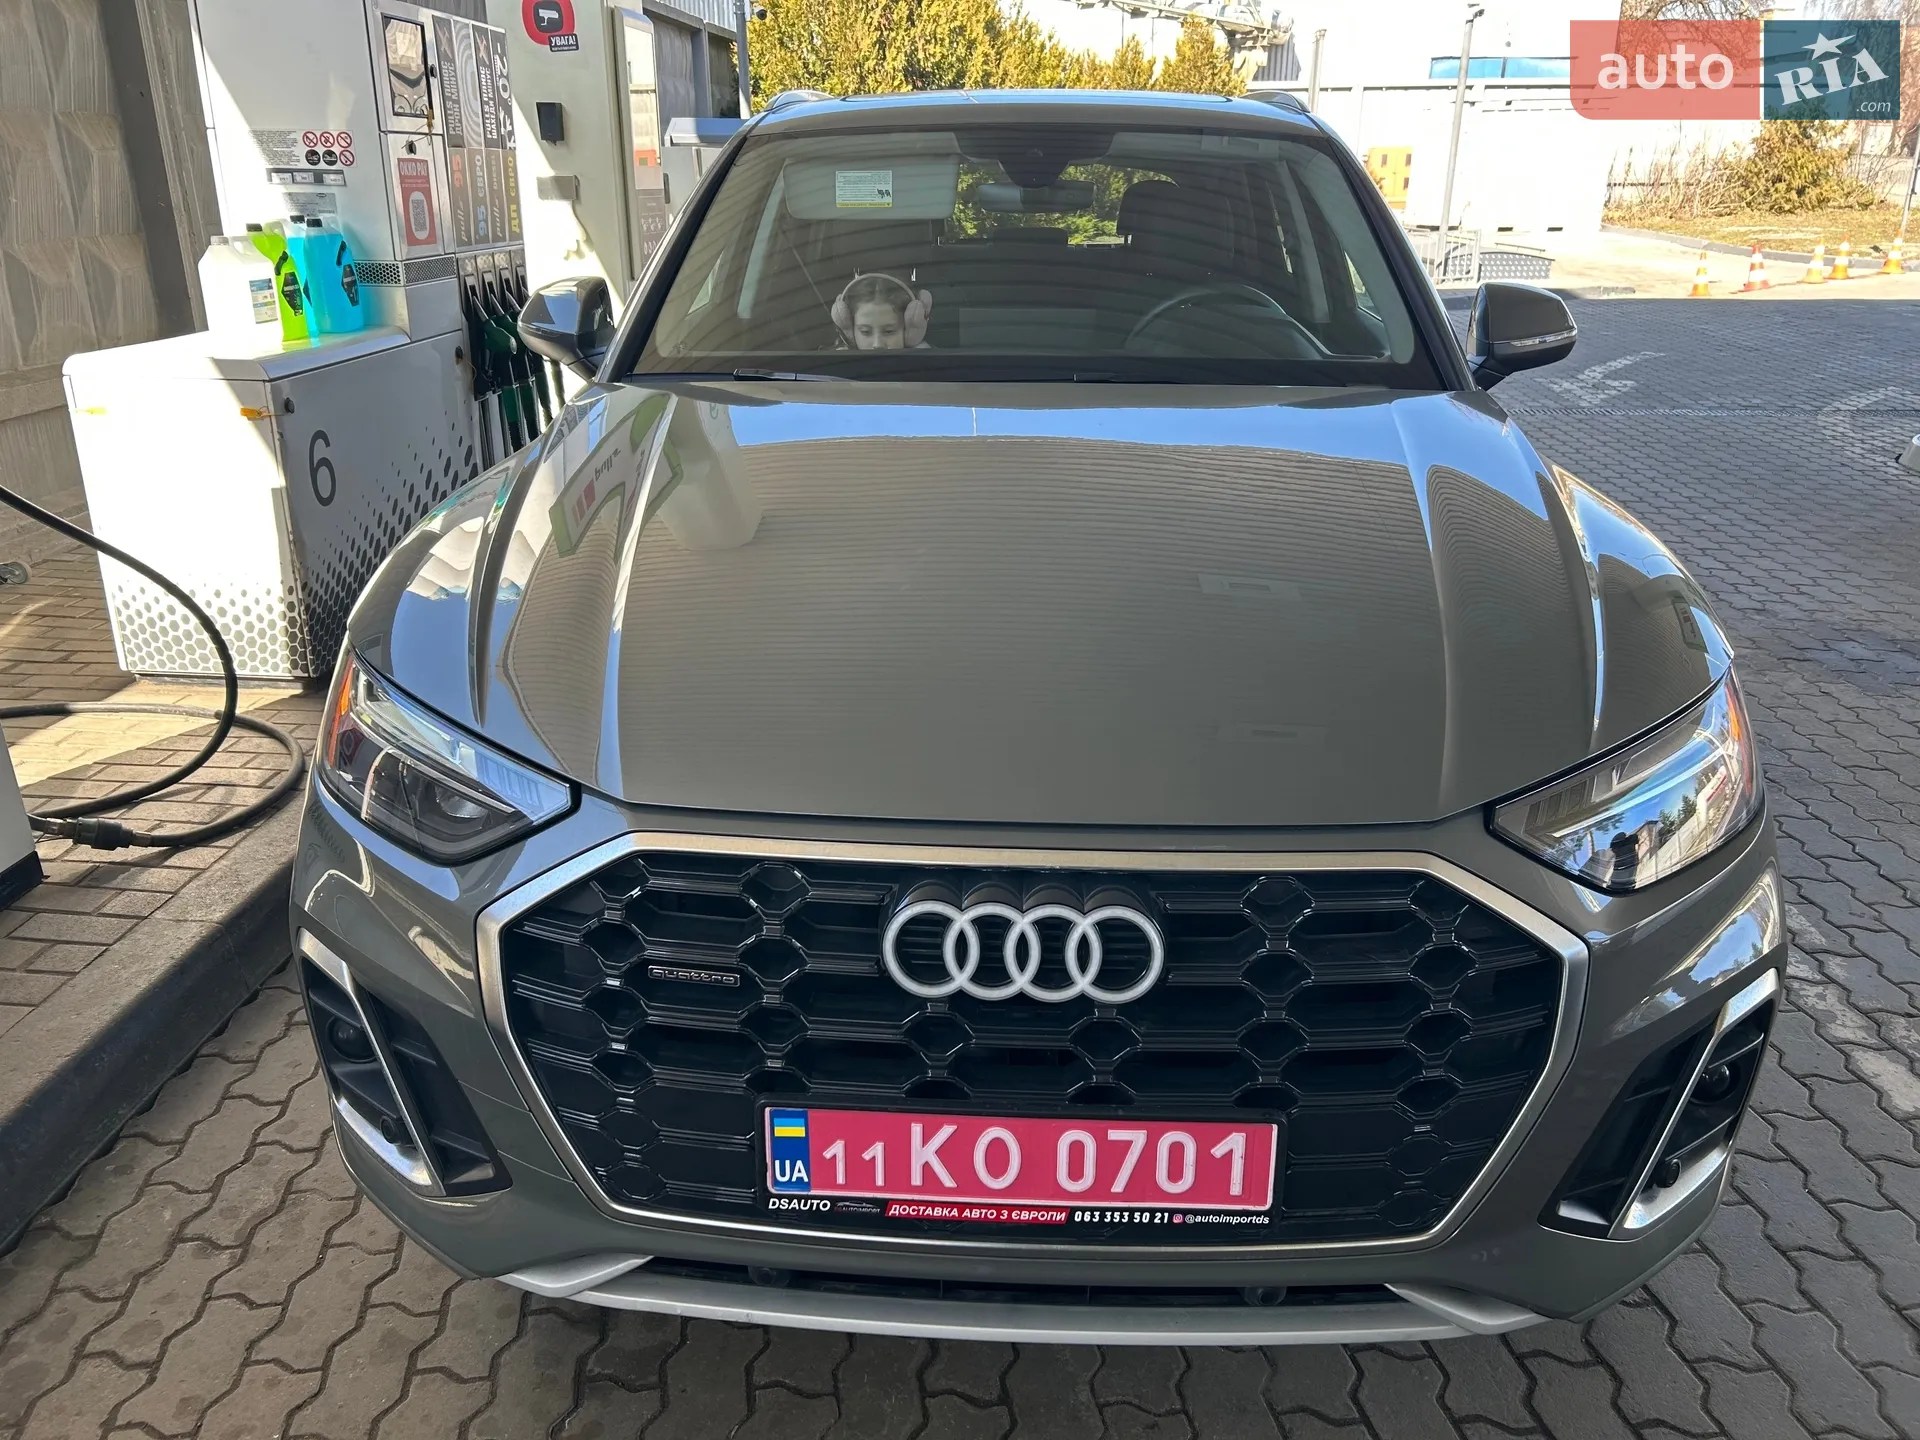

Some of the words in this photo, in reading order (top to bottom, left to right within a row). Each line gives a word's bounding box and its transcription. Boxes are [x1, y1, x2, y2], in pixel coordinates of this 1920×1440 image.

[551, 35, 576, 46] УВАГА!
[441, 61, 452, 96] ПЛЮС
[480, 66, 489, 101] ПЛЮС
[446, 101, 456, 135] PULLS
[483, 105, 492, 139] PULLS
[452, 155, 463, 187] 95
[477, 205, 488, 237] 95
[510, 204, 520, 234] ДП
[309, 429, 337, 507] 6
[652, 969, 735, 984] quattro
[774, 1159, 809, 1182] UA
[822, 1140, 885, 1187] 11
[1056, 1129, 1246, 1196] 0701
[768, 1198, 831, 1211] DSAUTO
[889, 1204, 959, 1218] ДОСТАВКА
[962, 1208, 997, 1219] АВТО
[1011, 1210, 1066, 1221] ЄВРОПИ
[1074, 1210, 1100, 1222] 063
[1104, 1211, 1130, 1223] 353
[1133, 1211, 1150, 1223] 50
[1153, 1212, 1169, 1223] 21
[1185, 1213, 1270, 1225] @autoimportds
